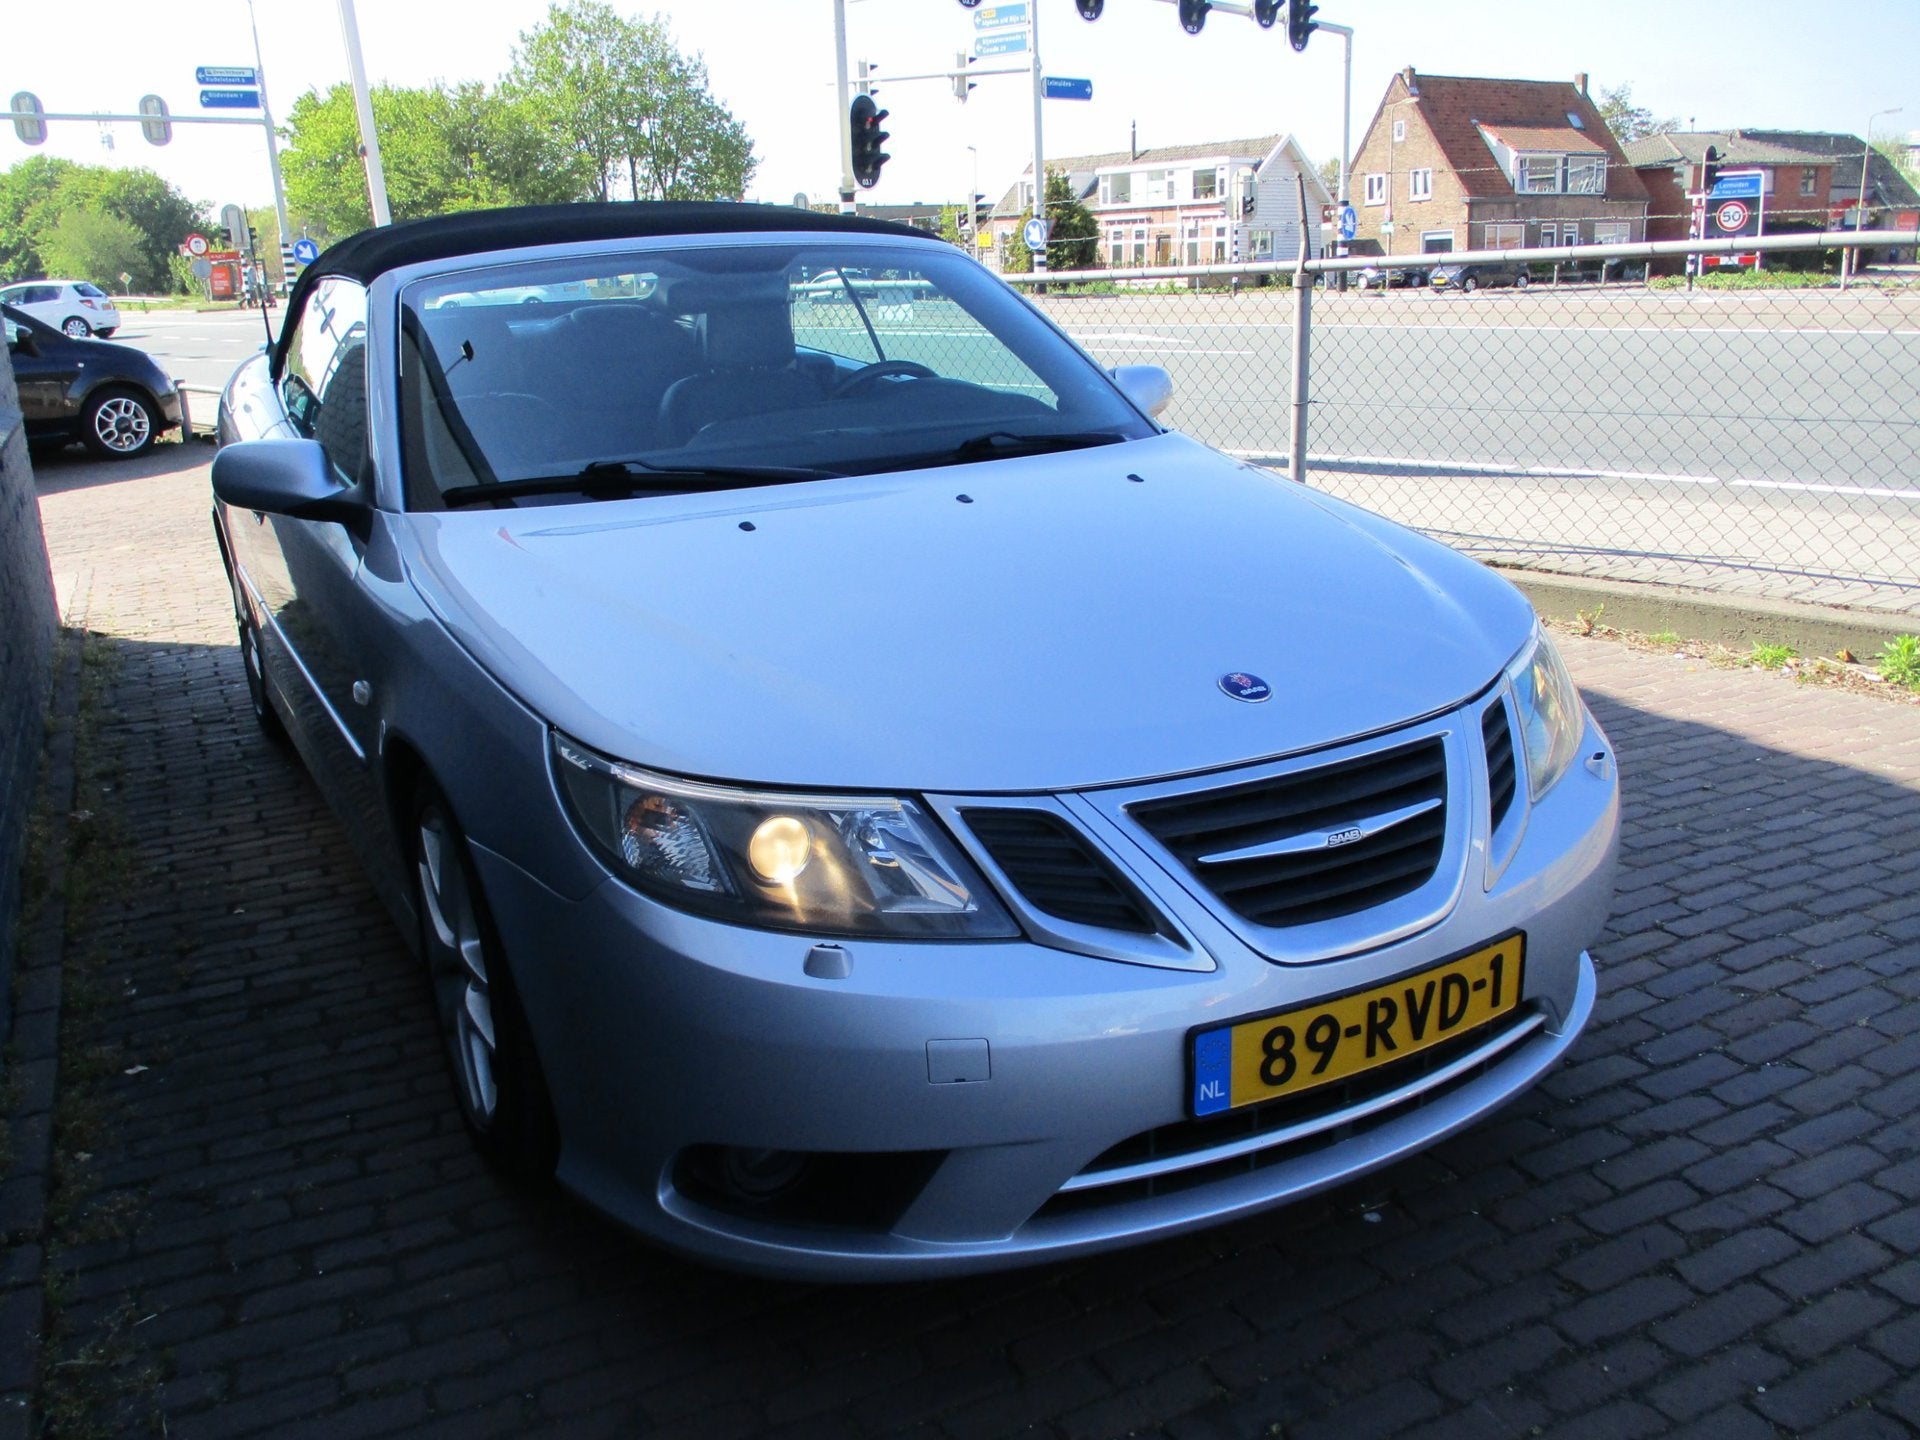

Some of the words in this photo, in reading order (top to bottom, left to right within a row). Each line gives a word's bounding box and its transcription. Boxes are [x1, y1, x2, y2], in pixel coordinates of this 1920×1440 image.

[1722, 211, 1742, 222] 50
[1328, 829, 1360, 846] SAAB
[1259, 953, 1504, 1087] 89-RVD-1
[1200, 1080, 1225, 1101] NL
